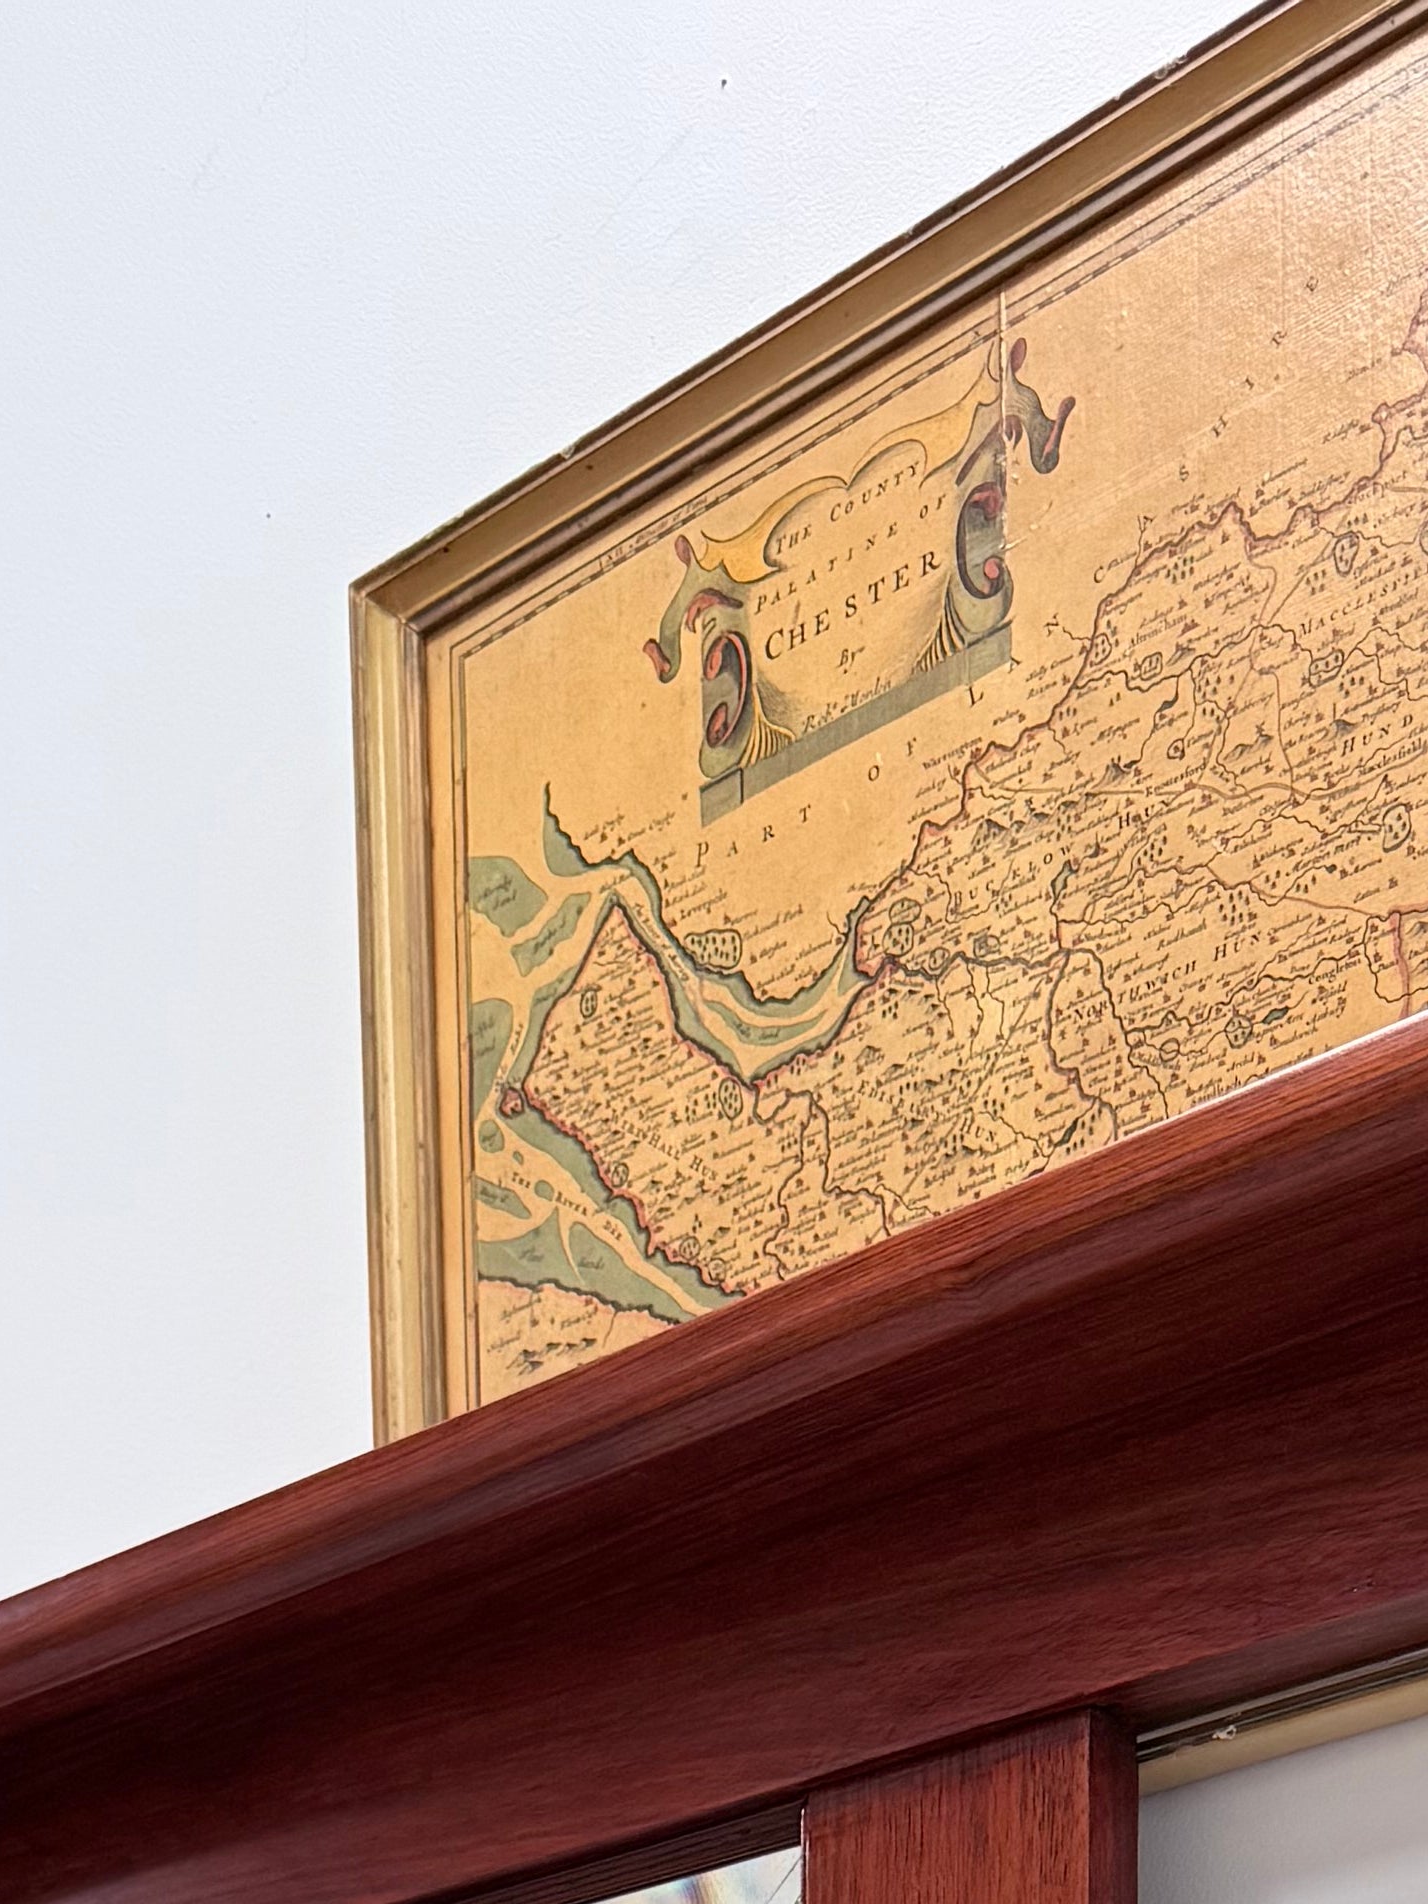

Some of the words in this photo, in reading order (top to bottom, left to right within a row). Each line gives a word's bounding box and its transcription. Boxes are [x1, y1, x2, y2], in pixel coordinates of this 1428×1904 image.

[754, 523, 899, 615] PALATINE
[919, 493, 947, 520] OF
[775, 524, 813, 555] THE
[830, 460, 921, 523] COUNTY
[764, 550, 943, 661] CHESTER
[695, 804, 813, 868] PART
